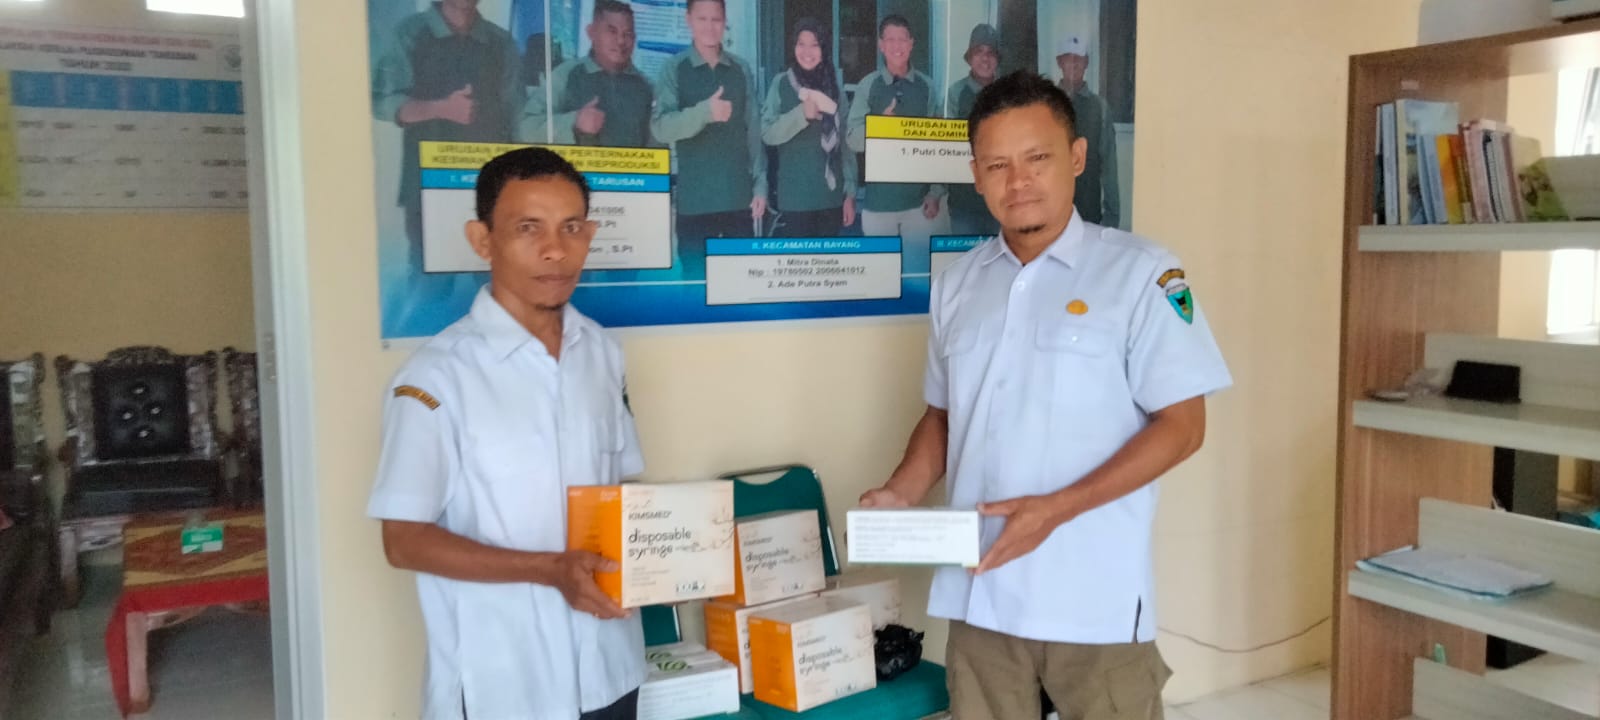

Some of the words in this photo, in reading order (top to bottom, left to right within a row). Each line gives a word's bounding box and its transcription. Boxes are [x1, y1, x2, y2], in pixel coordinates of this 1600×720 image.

[901, 120, 947, 129] URUSAN
[903, 129, 927, 137] DAN
[569, 149, 655, 159] PERTERNAKAN
[912, 148, 936, 156] Putri
[586, 160, 661, 169] REPRODUKSI
[591, 177, 645, 186] TARUSAN
[762, 241, 821, 250] KECAMATAN
[823, 241, 862, 249] BAYANG
[786, 258, 809, 266] Mitra
[811, 258, 840, 266] Dinata
[777, 280, 796, 288] Ade
[798, 280, 822, 288] Putra
[628, 528, 691, 546] disposable
[628, 544, 673, 560] syringe
